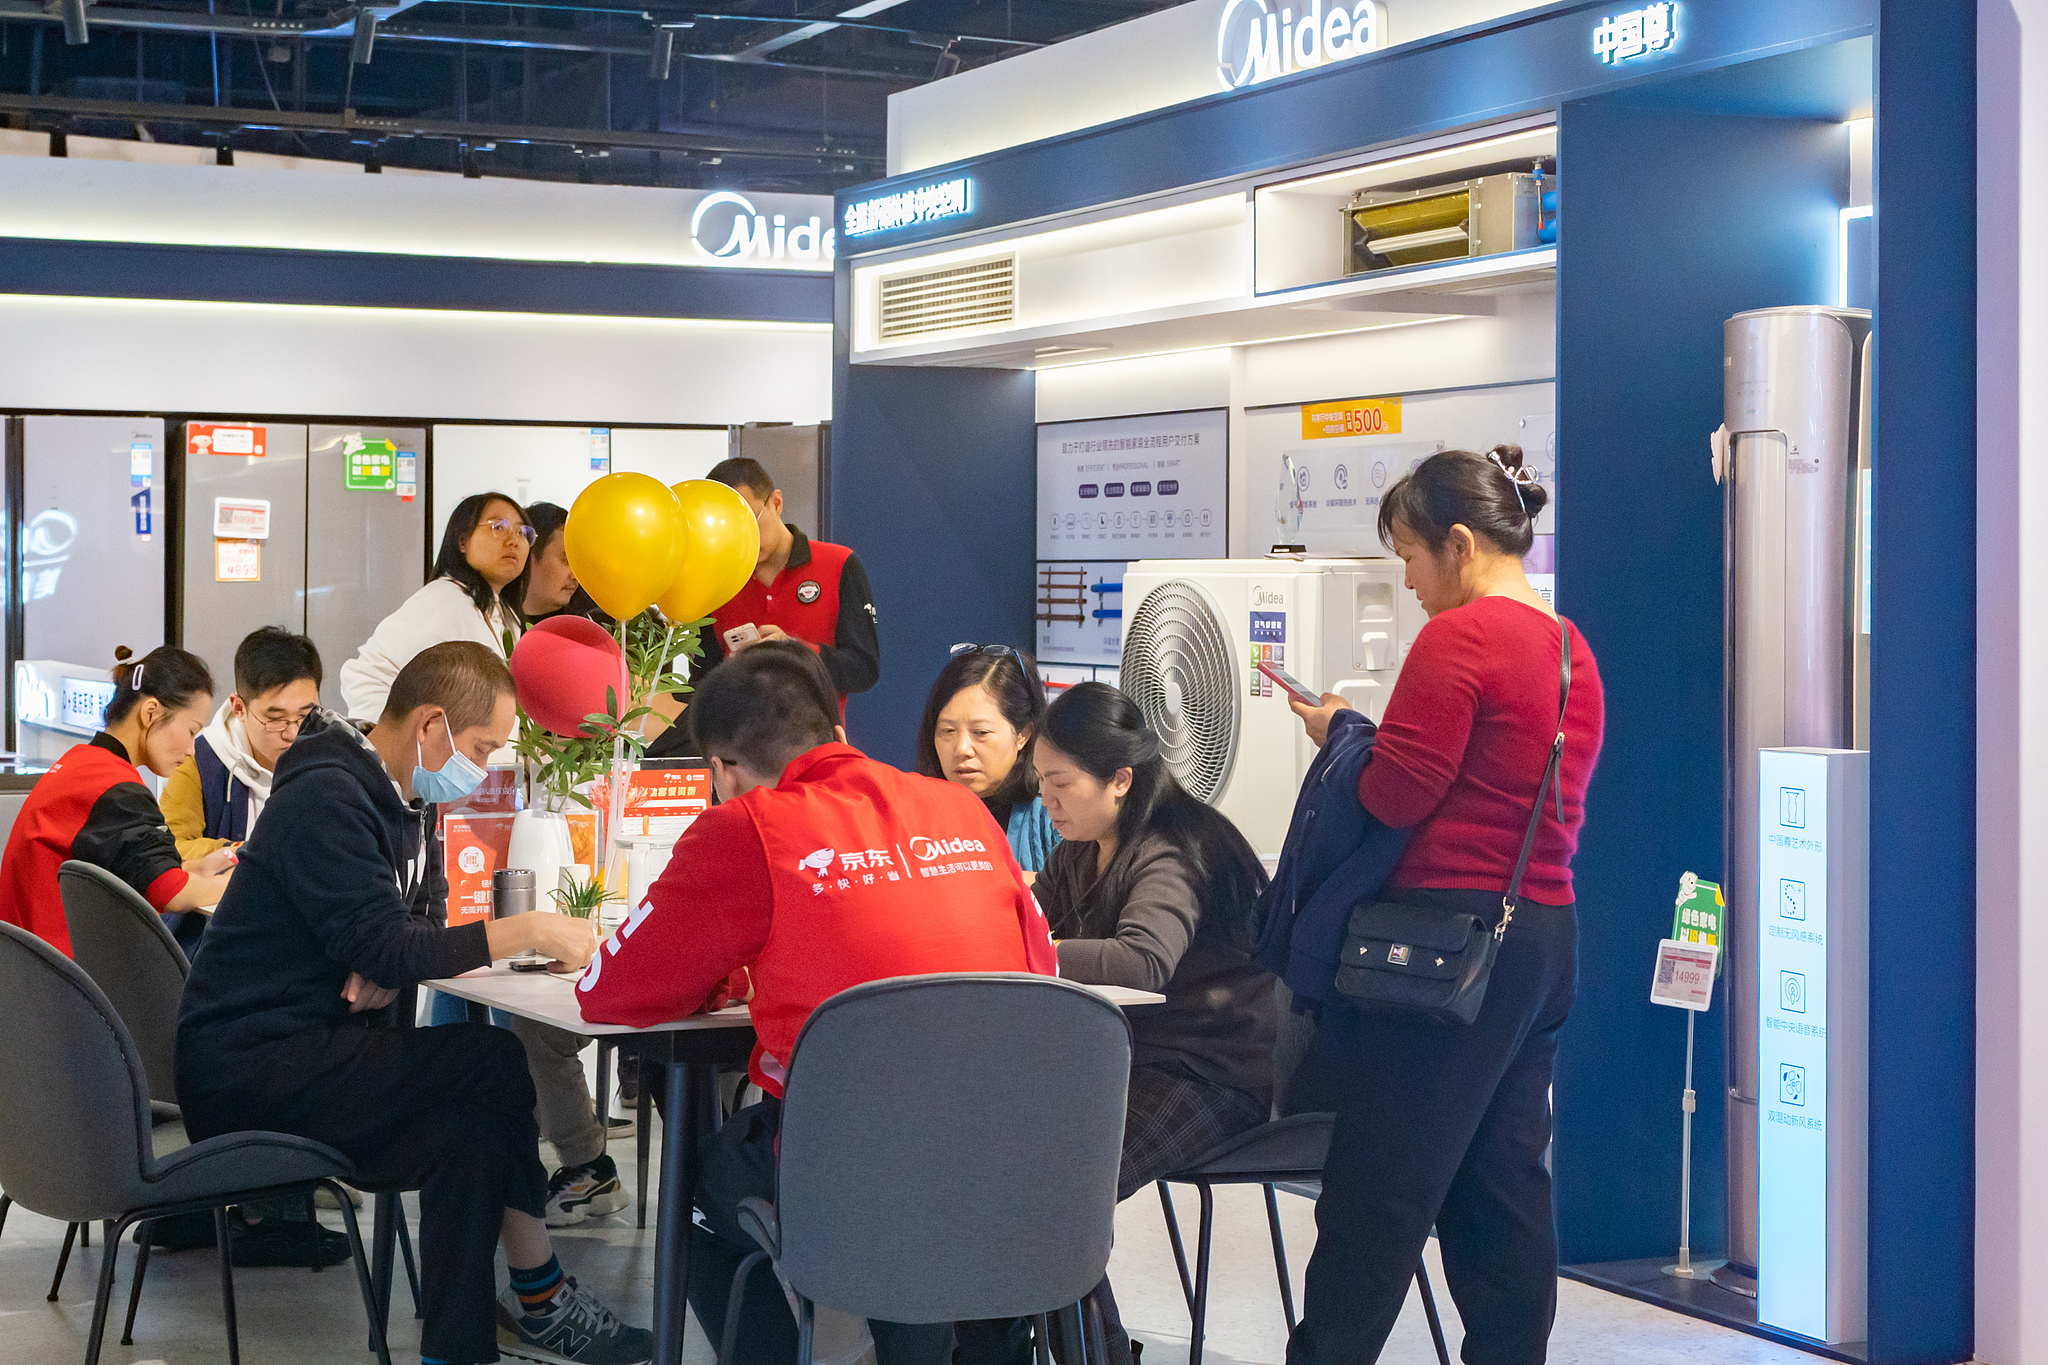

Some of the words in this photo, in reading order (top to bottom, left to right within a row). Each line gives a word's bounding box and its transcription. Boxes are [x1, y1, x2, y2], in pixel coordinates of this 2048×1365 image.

[1593, 1, 1677, 65] 中国尊
[1216, 0, 1377, 92] Midea
[1354, 406, 1382, 433] 500
[1253, 585, 1284, 606] Midea
[909, 836, 986, 861] Midea
[1768, 834, 1823, 853] 中国尊艺术外形
[839, 848, 894, 872] 京东
[919, 860, 994, 878] 智慧生活可以更美的
[1681, 907, 1717, 931] 绿色家电
[1768, 924, 1824, 946] 定制无风感系统
[1765, 1016, 1827, 1039] 智能中央语音系统
[1767, 1109, 1823, 1131] 双混动新风系统
